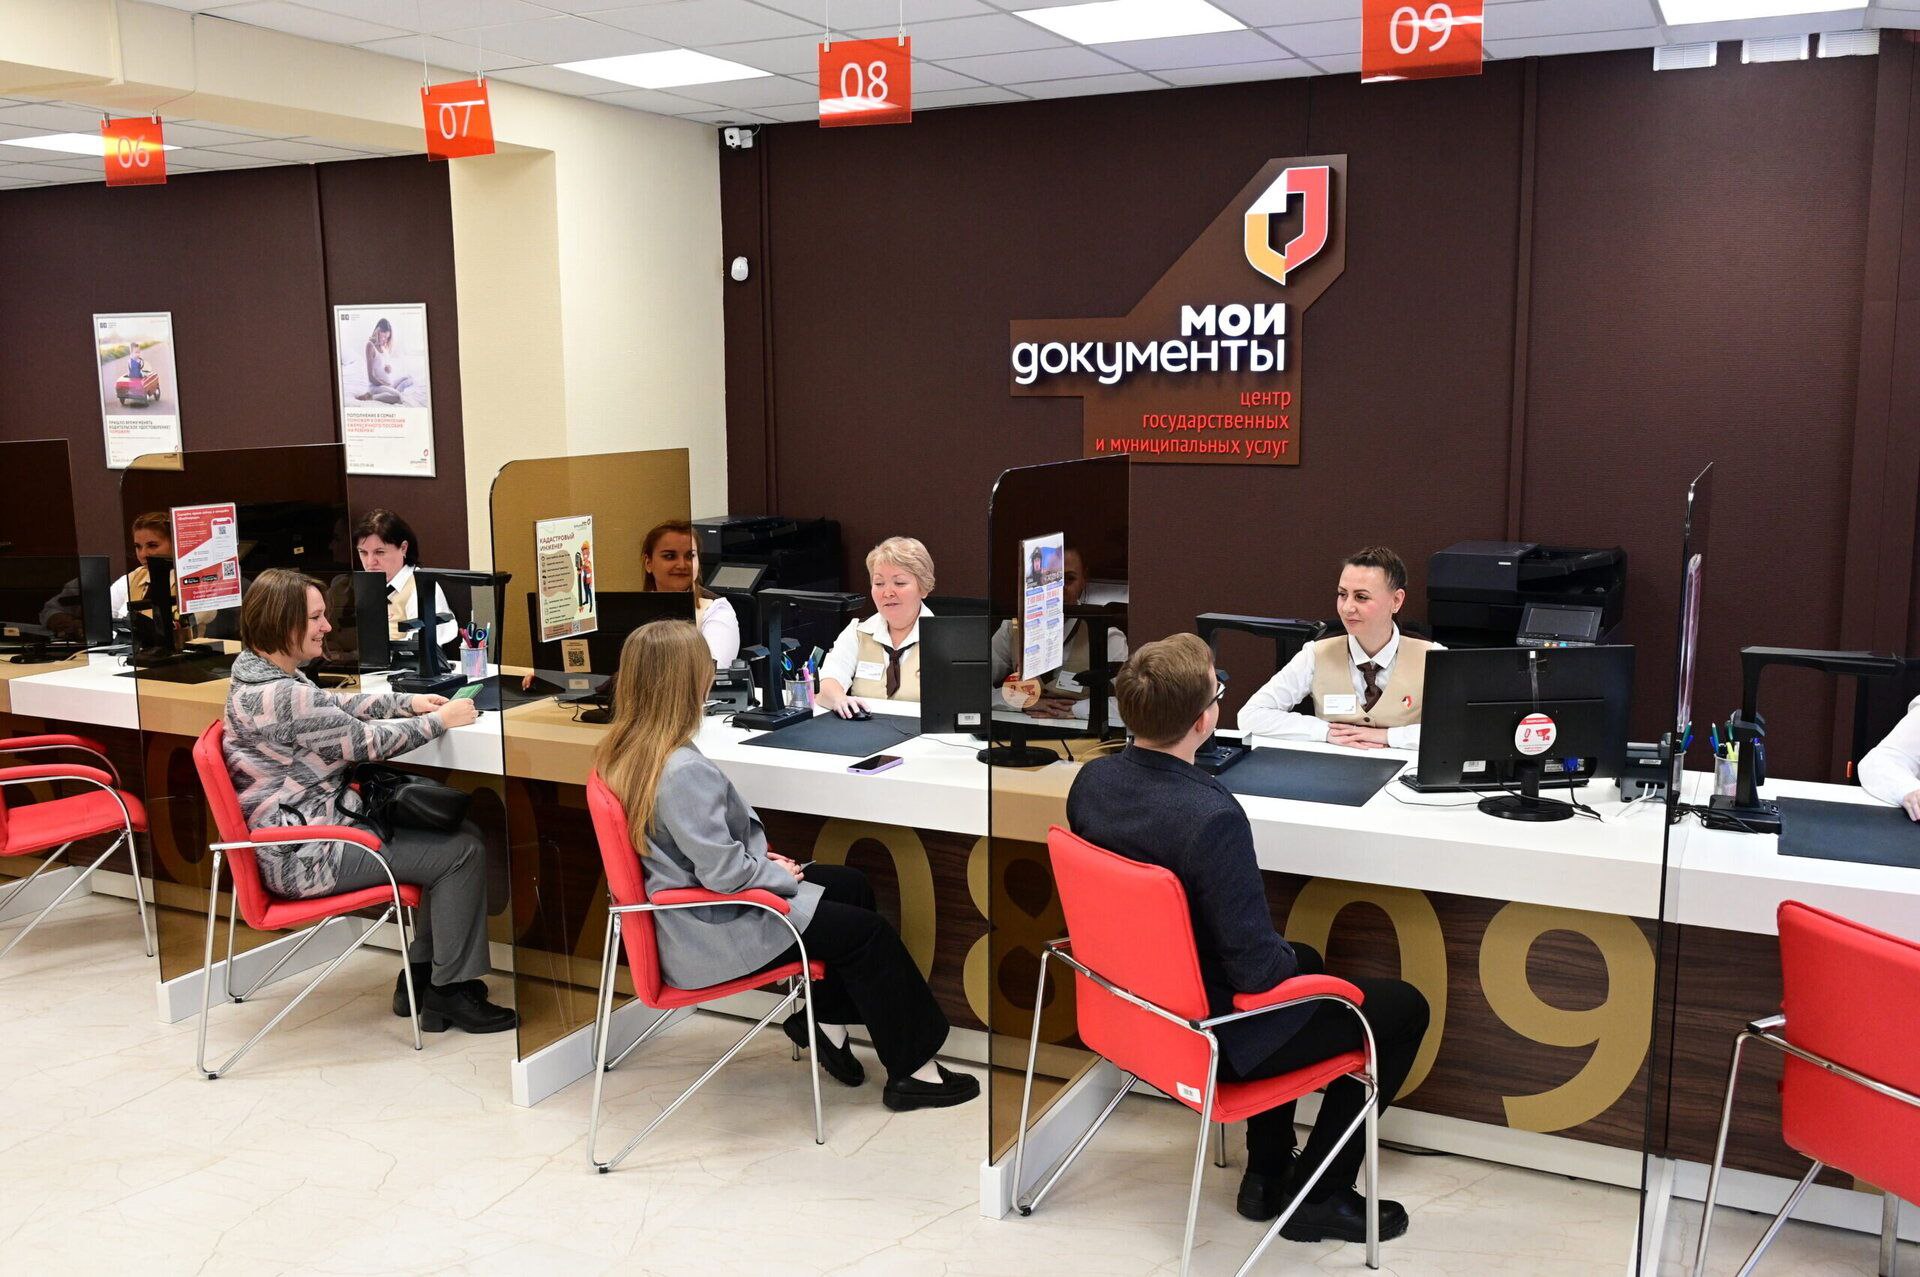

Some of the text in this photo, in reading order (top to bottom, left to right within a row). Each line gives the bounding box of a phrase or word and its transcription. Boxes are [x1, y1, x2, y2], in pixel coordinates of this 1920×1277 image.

[1389, 2, 1453, 54] 09
[840, 60, 888, 104] 08
[439, 103, 472, 139] 07
[118, 135, 150, 168] 06
[1240, 391, 1292, 410] центр
[1142, 412, 1290, 432] государственных
[1095, 439, 1289, 459] и муниципальных услуг
[539, 533, 575, 544] КАДАСТРОВЫЙ
[540, 543, 563, 551] ИНЖЕНЕР
[1284, 876, 1656, 1133] 09
